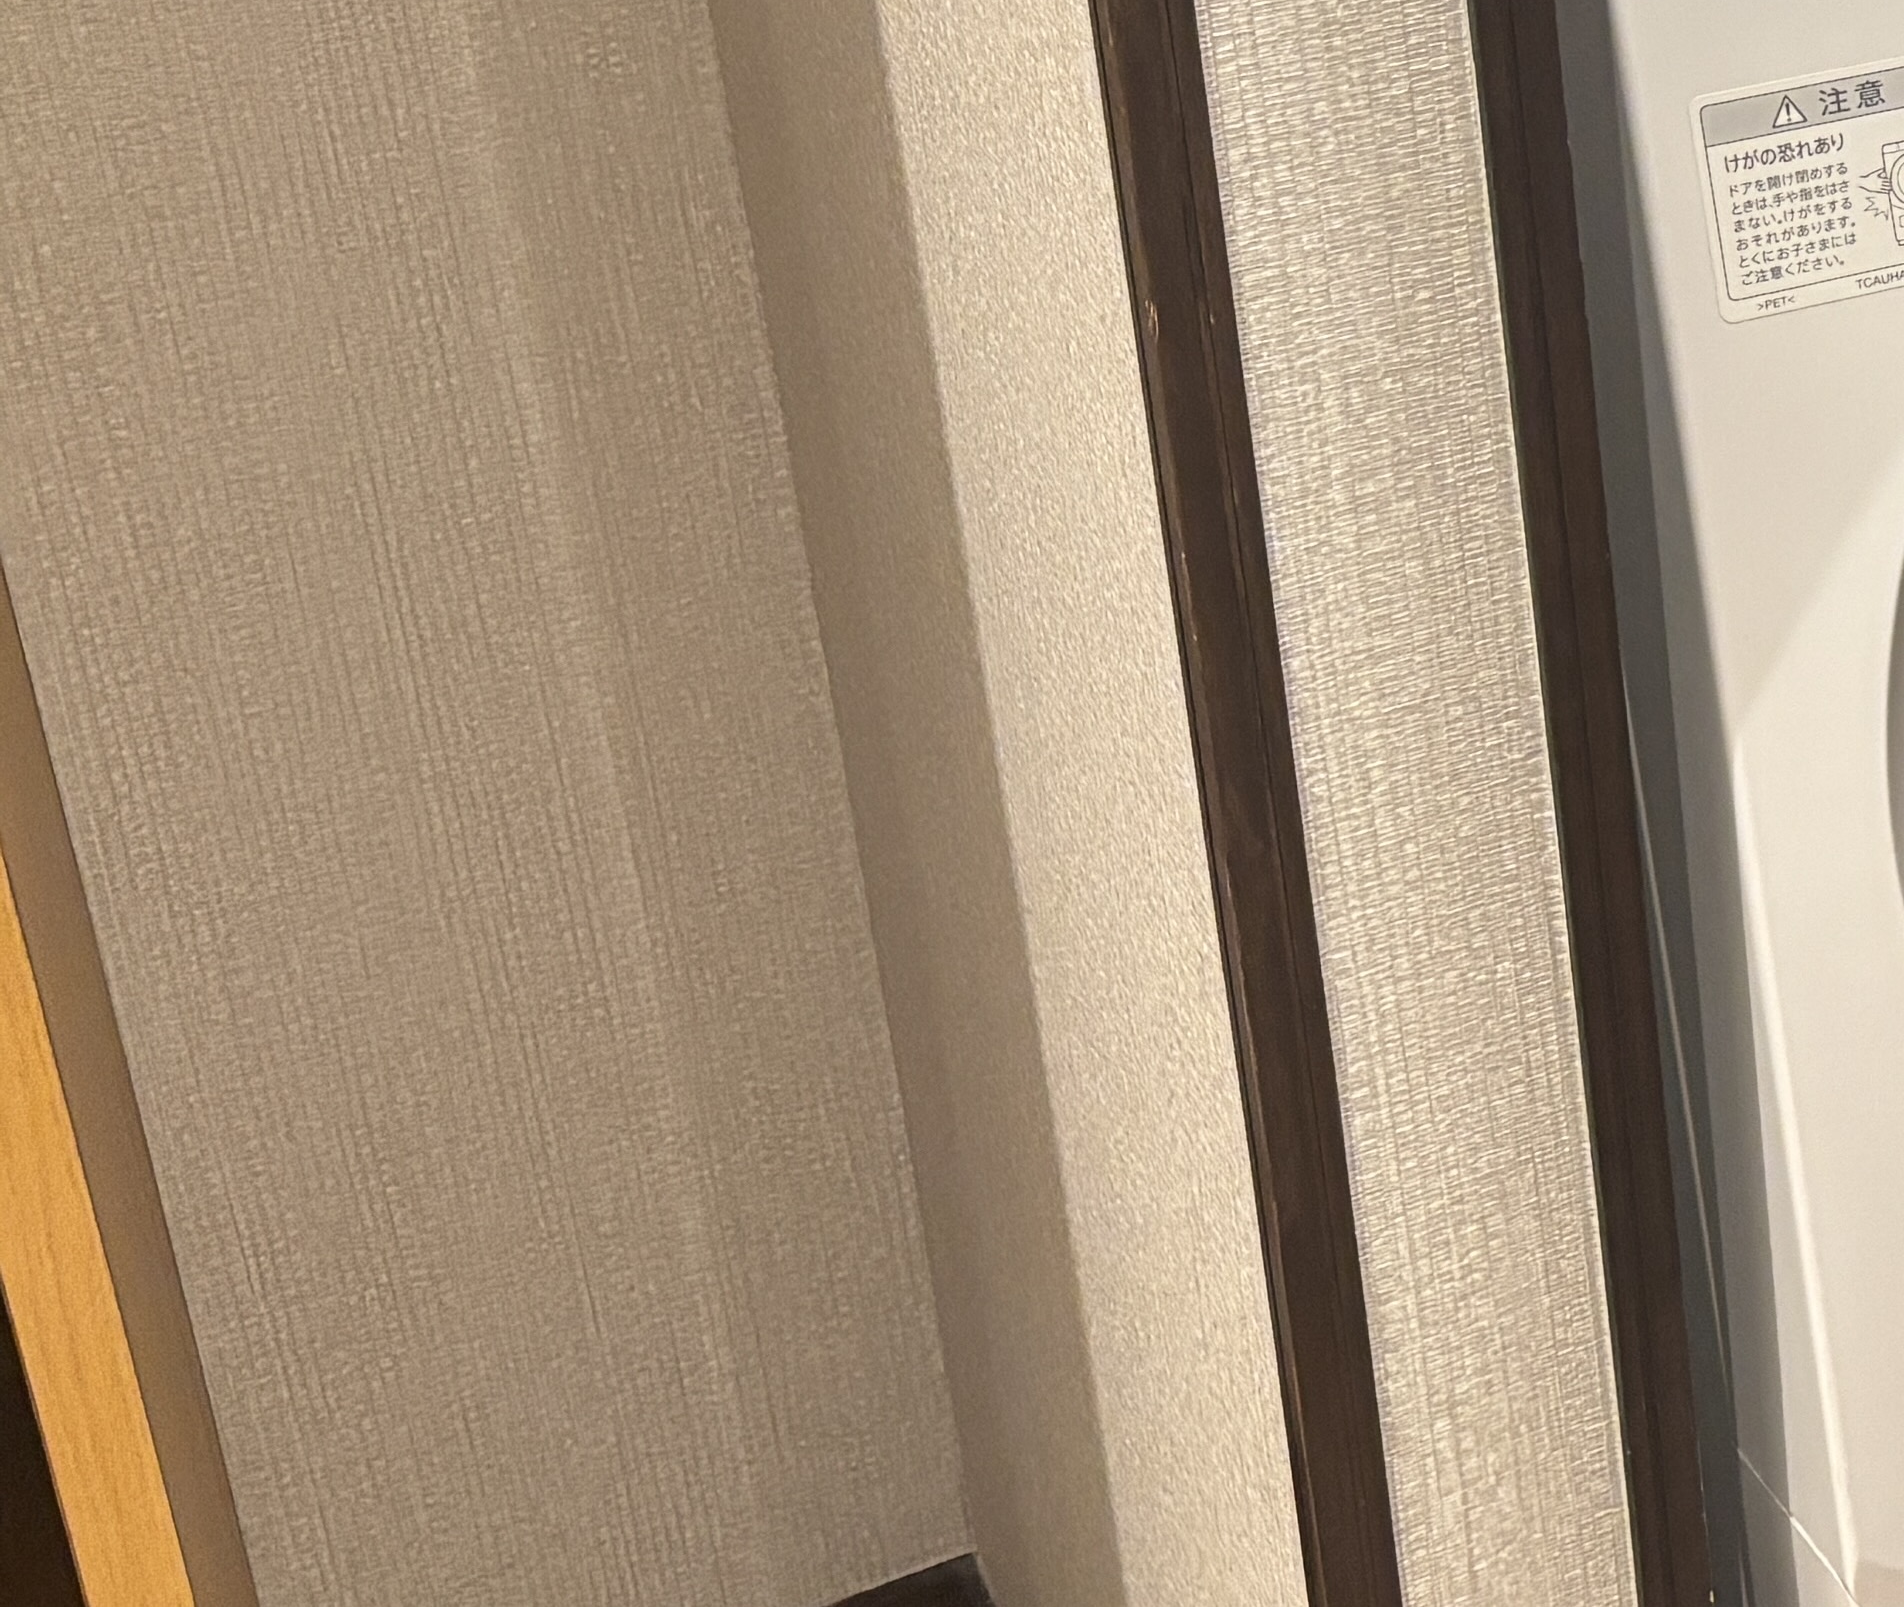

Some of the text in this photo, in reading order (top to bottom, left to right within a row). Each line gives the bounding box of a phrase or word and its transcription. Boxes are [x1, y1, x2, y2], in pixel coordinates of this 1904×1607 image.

[1818, 79, 1886, 117] 注意
[1724, 132, 1845, 173] けがの恐れあり
[1728, 162, 1849, 197] ドアを開け閉めする
[1731, 180, 1850, 215] ときは、手や指をはさ
[1733, 197, 1853, 232] まない。けがをする
[1735, 215, 1857, 250] おそれがあります。
[1738, 232, 1857, 269] とくにお子さまには
[1740, 254, 1846, 286] ご注意ください。
